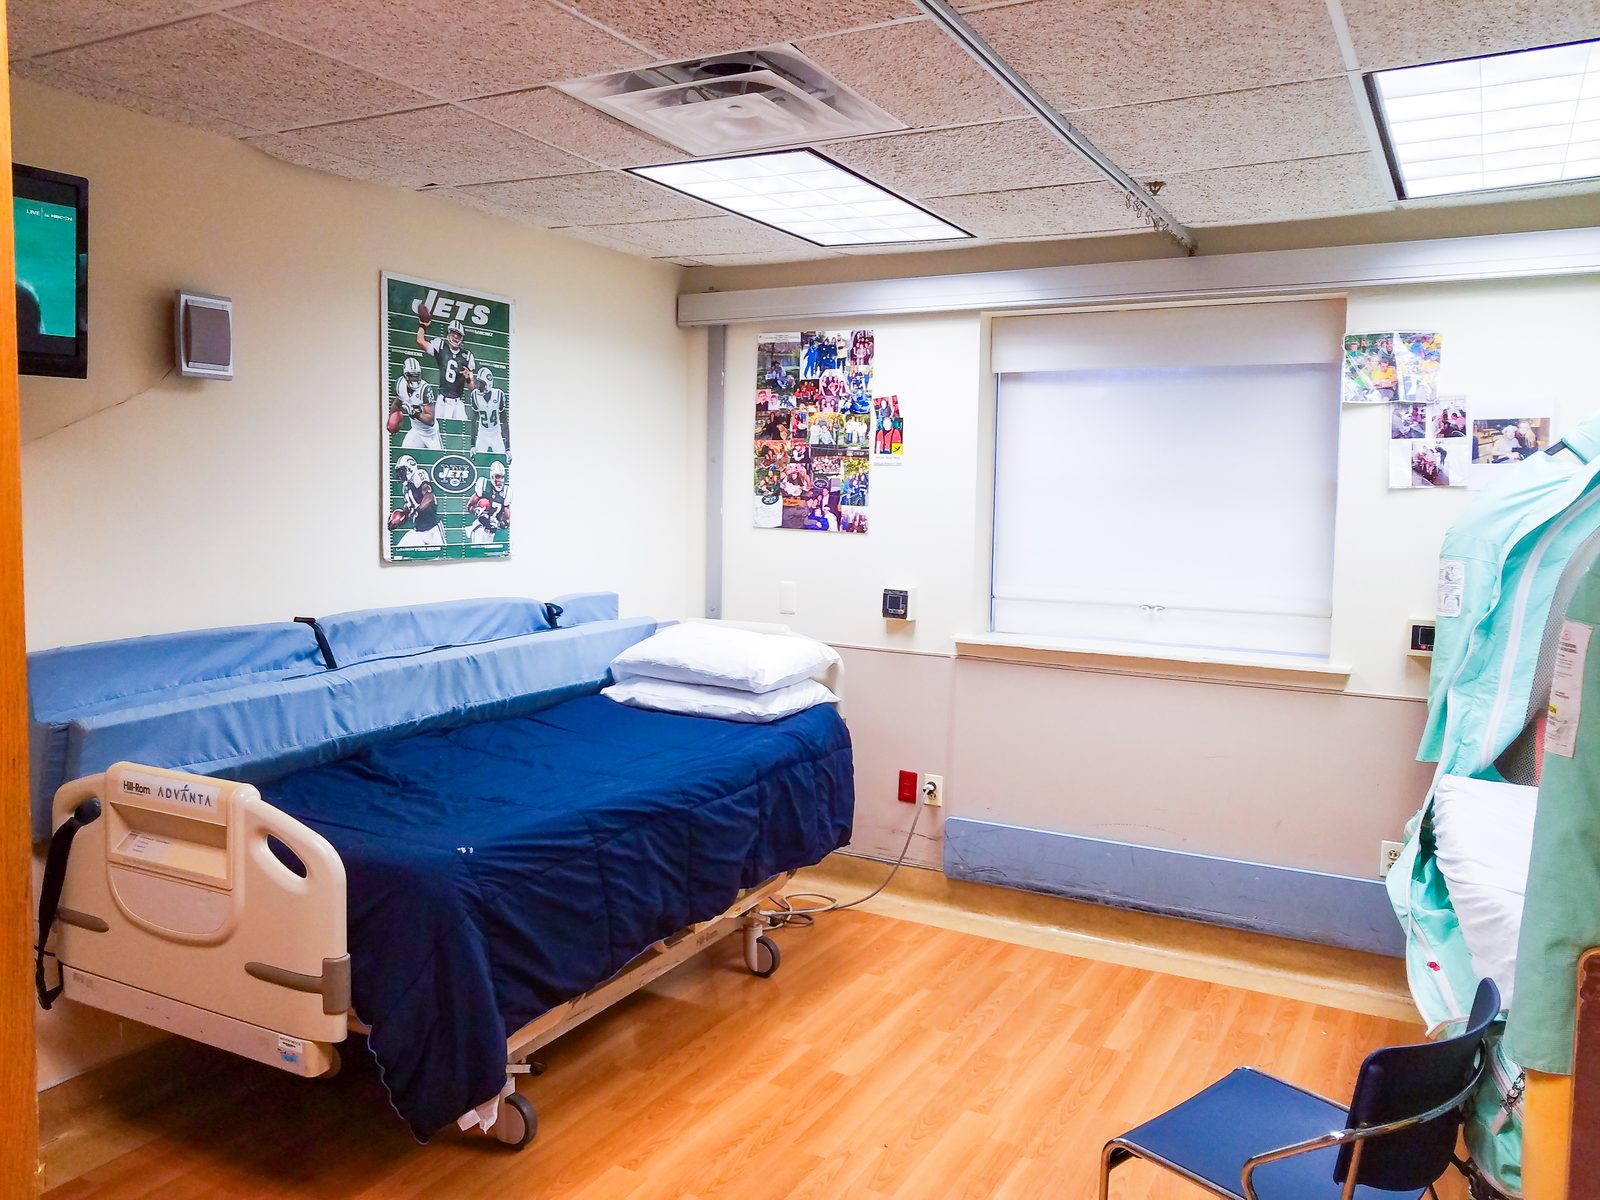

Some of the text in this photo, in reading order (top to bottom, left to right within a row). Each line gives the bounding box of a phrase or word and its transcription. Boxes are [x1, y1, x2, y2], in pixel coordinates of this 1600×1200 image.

[412, 290, 490, 325] JETS
[446, 360, 458, 383] 6
[438, 467, 470, 479] JETS
[123, 780, 151, 795] Hill-Rom
